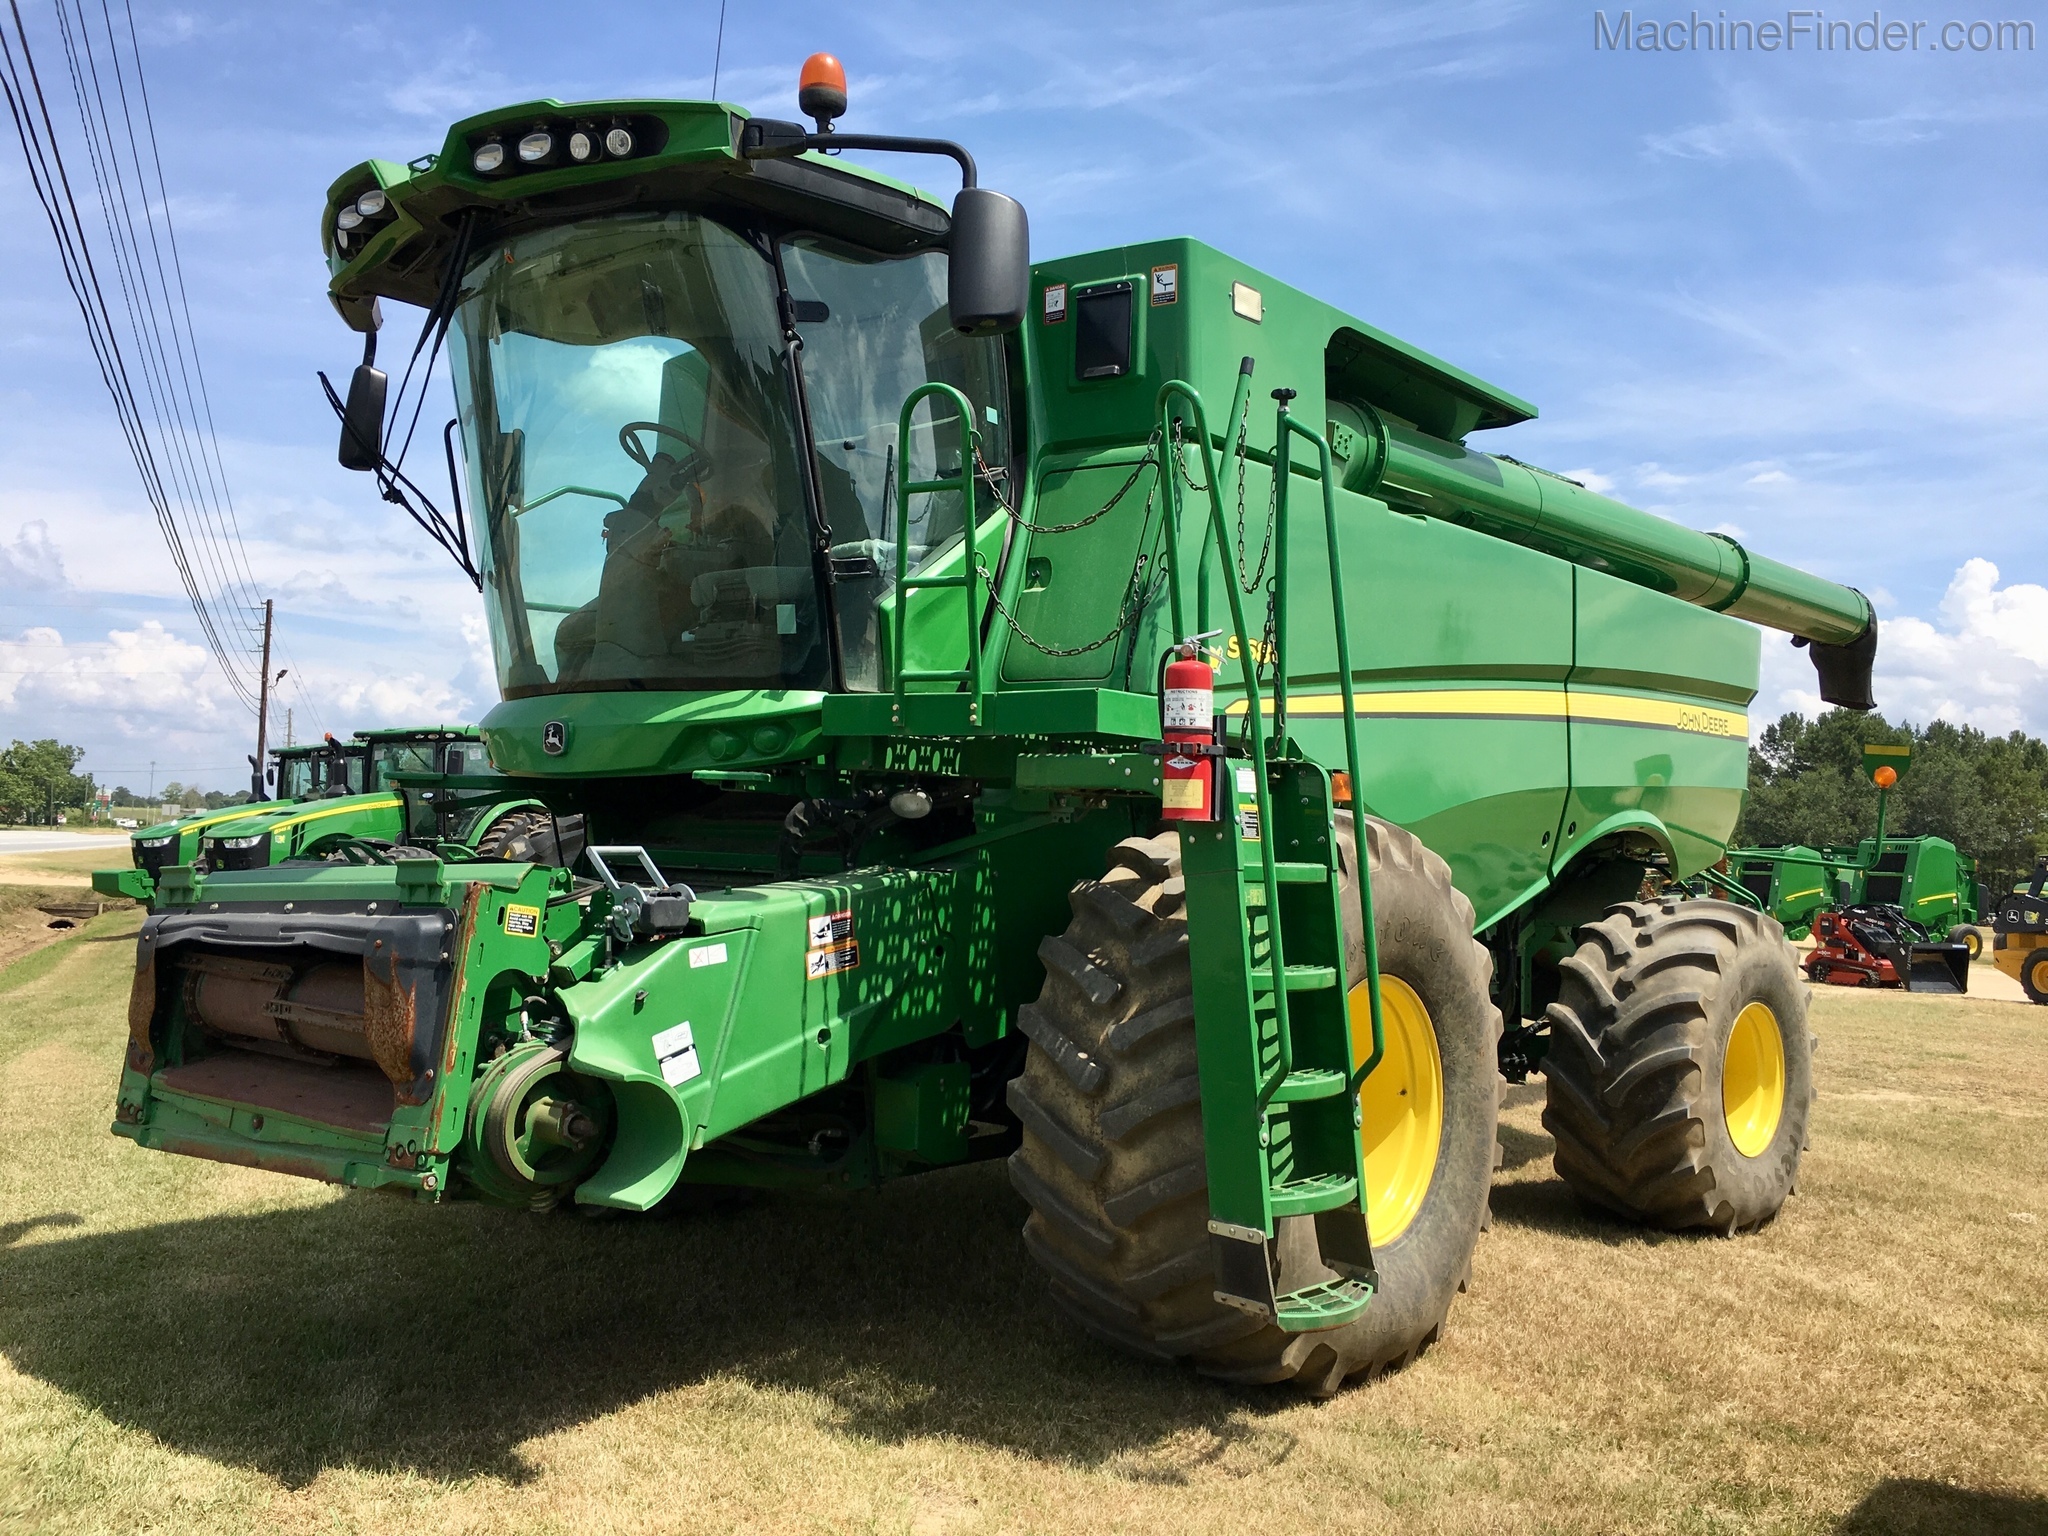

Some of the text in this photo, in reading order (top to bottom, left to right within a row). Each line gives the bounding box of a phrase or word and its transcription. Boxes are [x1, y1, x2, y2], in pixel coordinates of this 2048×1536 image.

[1677, 707, 1729, 733] JOHN DEERE
[513, 906, 538, 915] CAUTION
